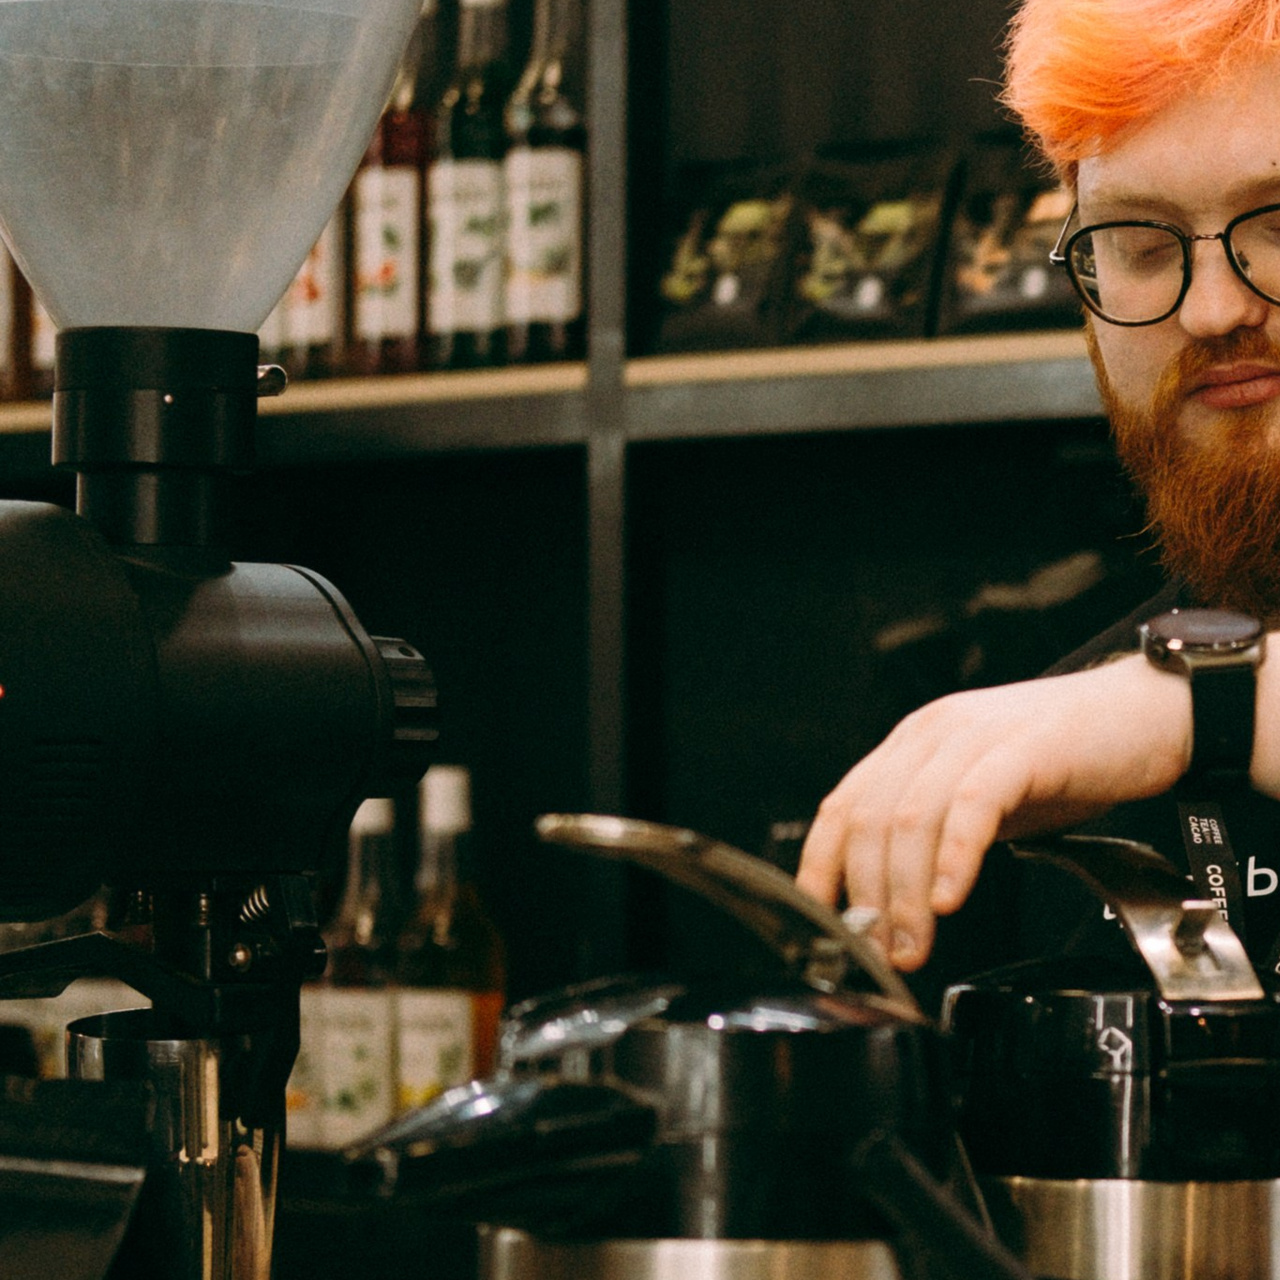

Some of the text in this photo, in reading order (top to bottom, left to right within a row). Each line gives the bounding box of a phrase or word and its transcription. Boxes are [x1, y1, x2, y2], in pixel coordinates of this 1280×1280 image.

[1188, 816, 1202, 844] CACAO
[1209, 818, 1223, 845] COFFEE
[1206, 864, 1228, 923] COFF
